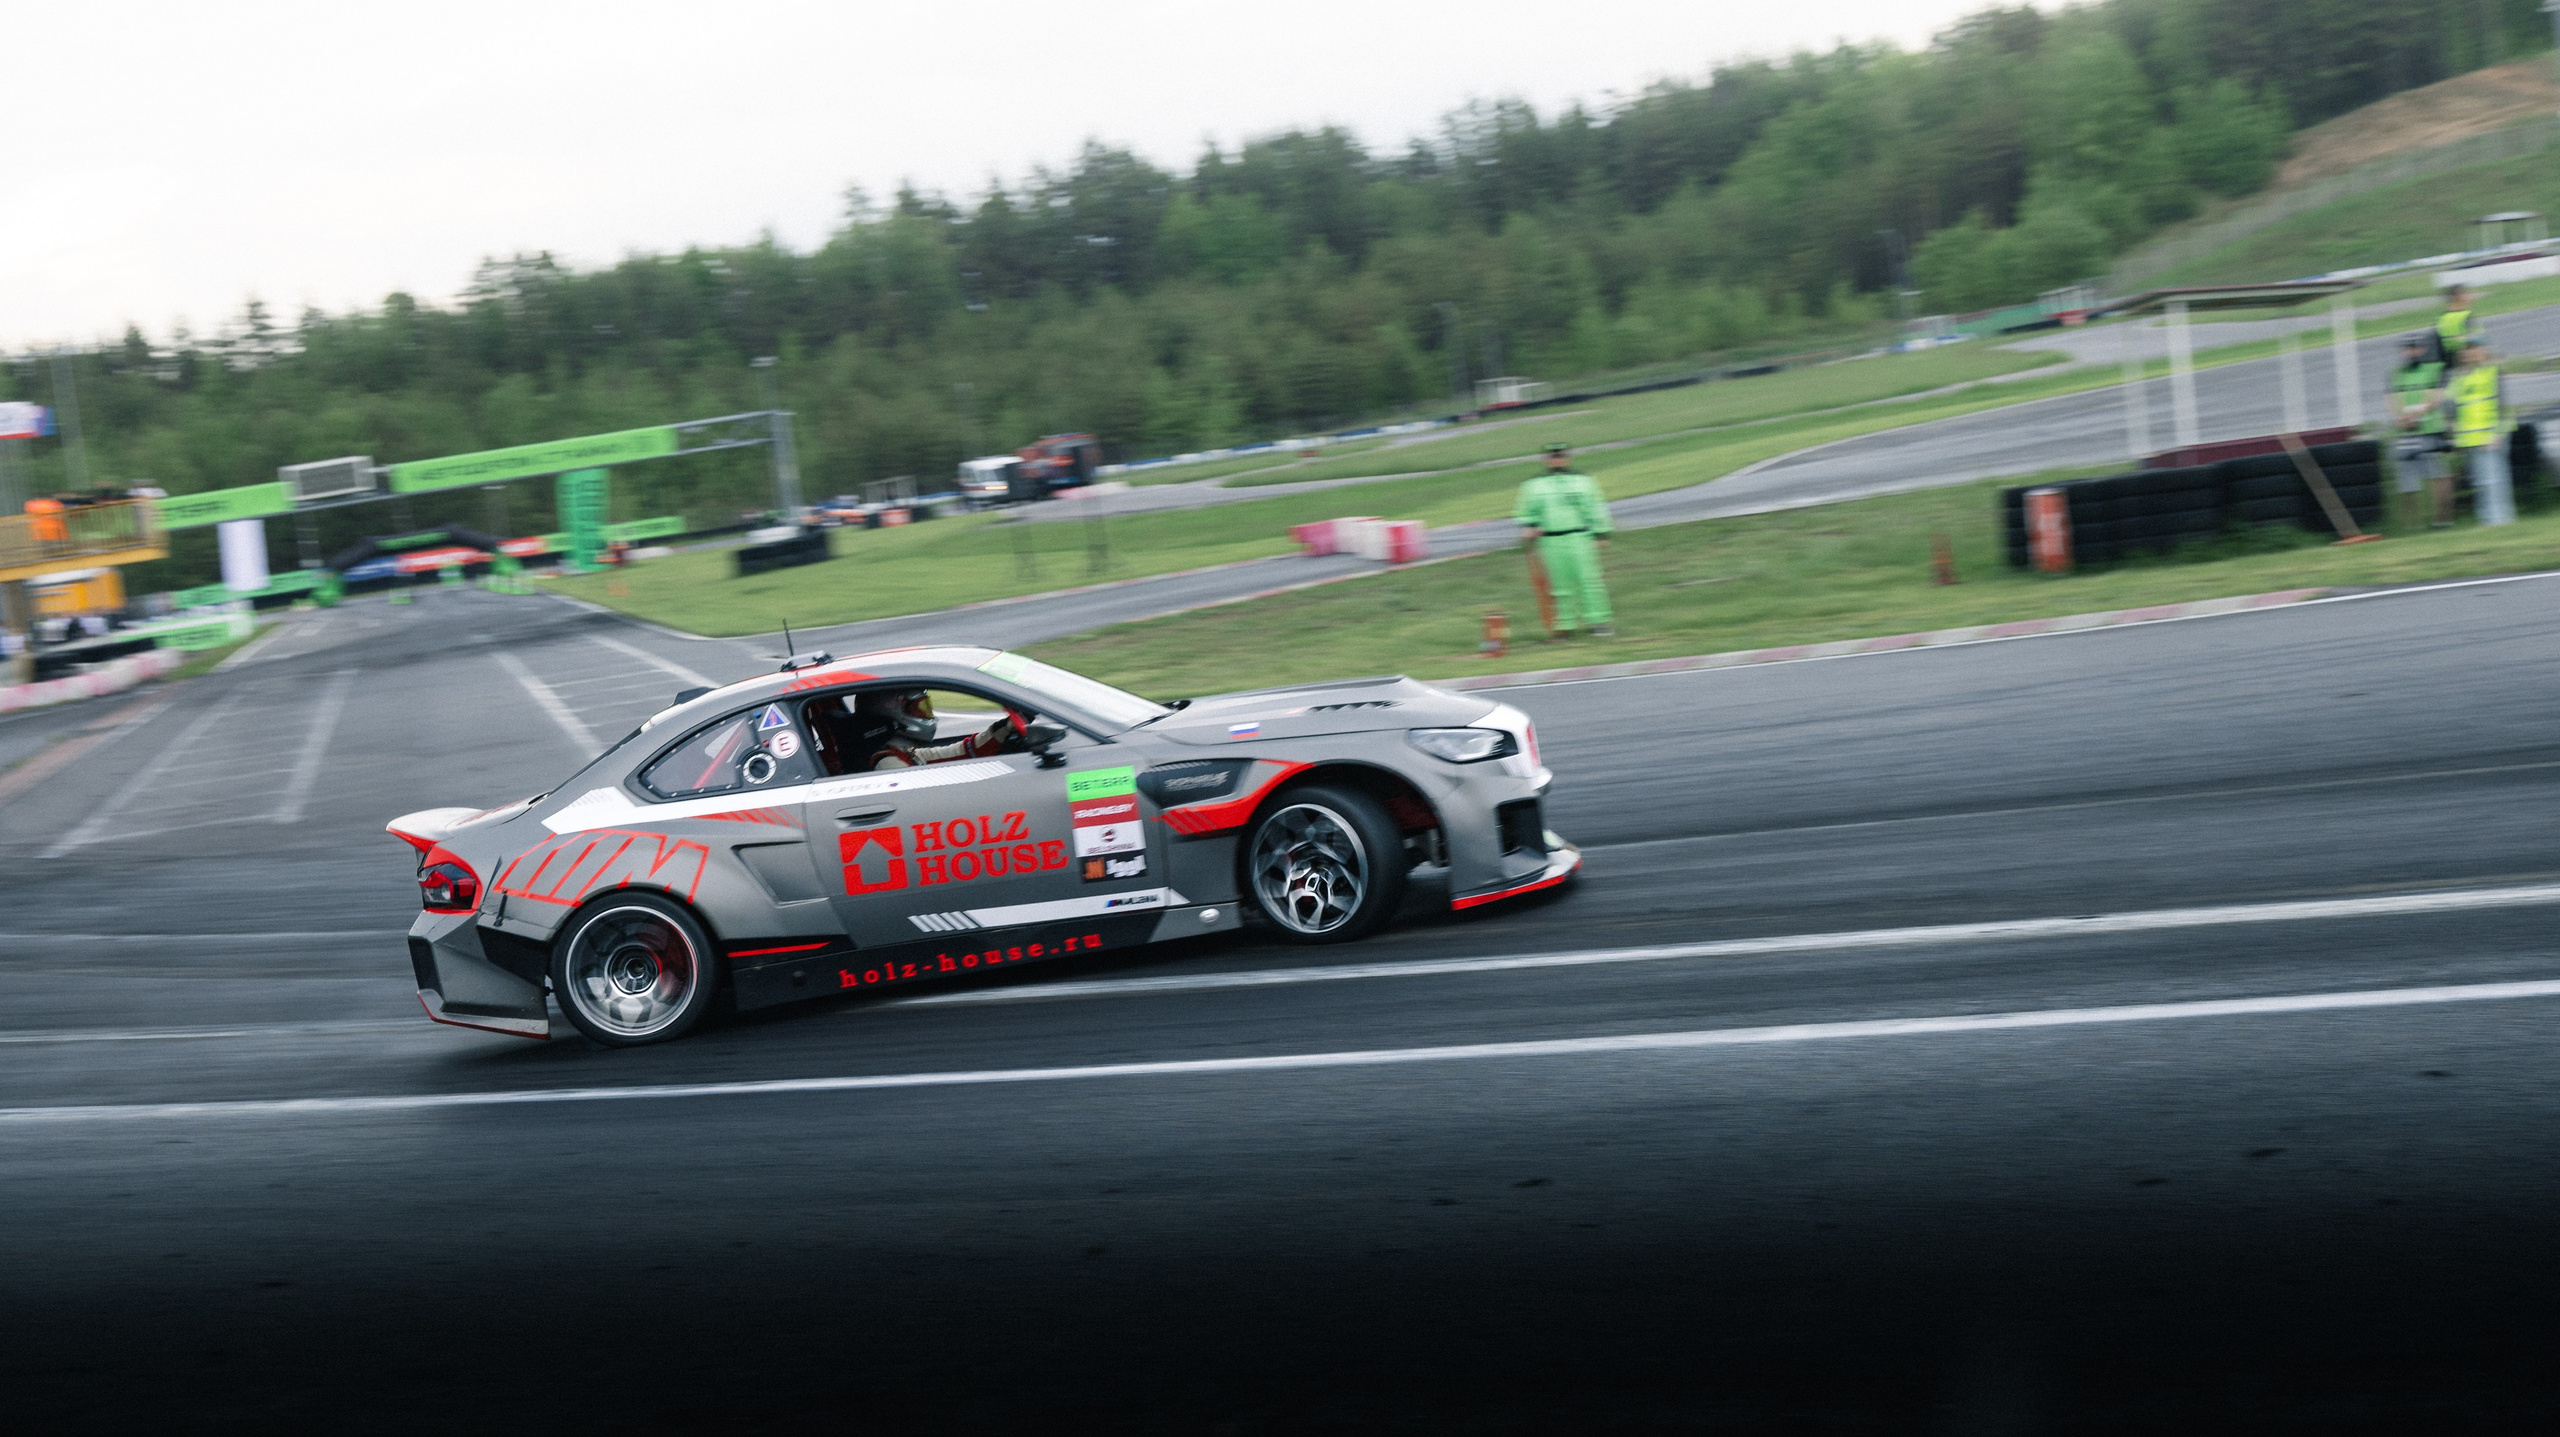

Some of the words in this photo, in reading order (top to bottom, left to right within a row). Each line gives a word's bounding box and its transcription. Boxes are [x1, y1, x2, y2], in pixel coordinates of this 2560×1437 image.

[911, 810, 1030, 853] HOLZ
[916, 839, 1070, 886] HOUSE
[838, 933, 1103, 989] holz-house.ru
